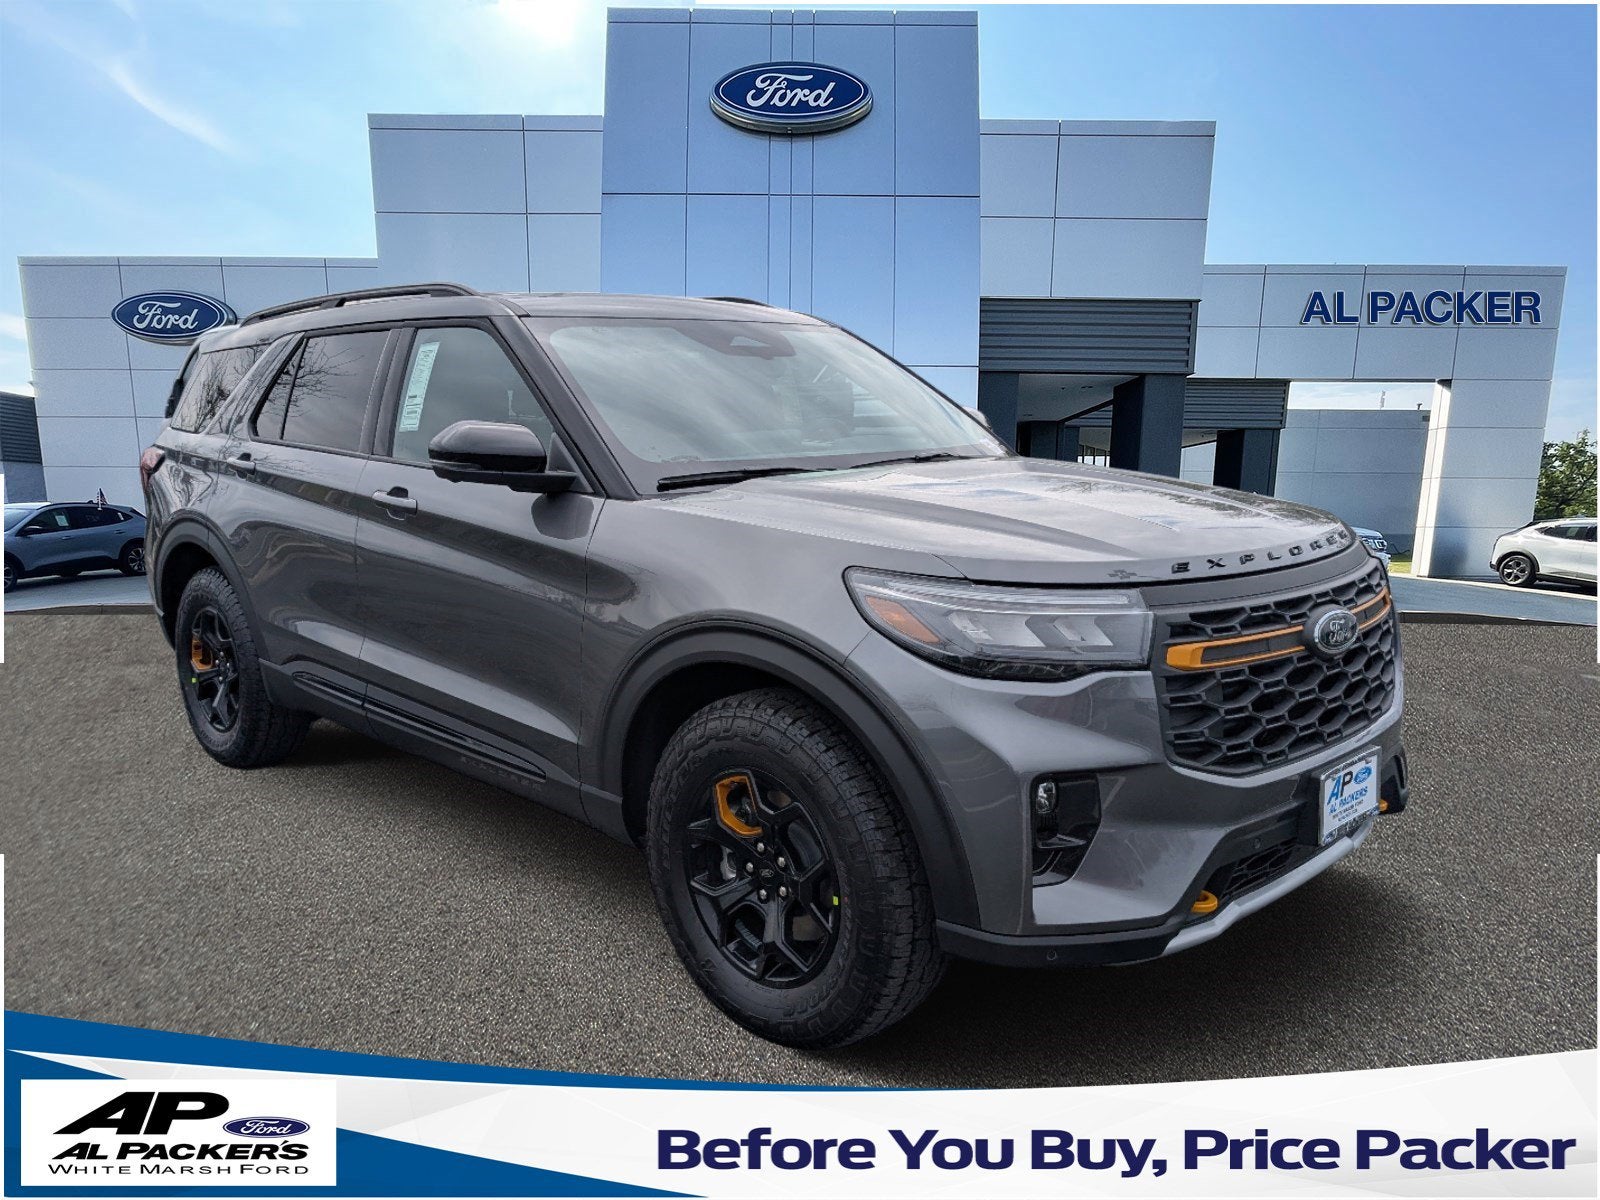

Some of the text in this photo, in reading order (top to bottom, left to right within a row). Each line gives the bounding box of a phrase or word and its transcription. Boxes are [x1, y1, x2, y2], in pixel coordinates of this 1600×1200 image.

[746, 73, 836, 107] Ford
[133, 301, 199, 329] Ford
[1301, 290, 1542, 325] AL PACKER
[1171, 529, 1348, 574] EXPLORER
